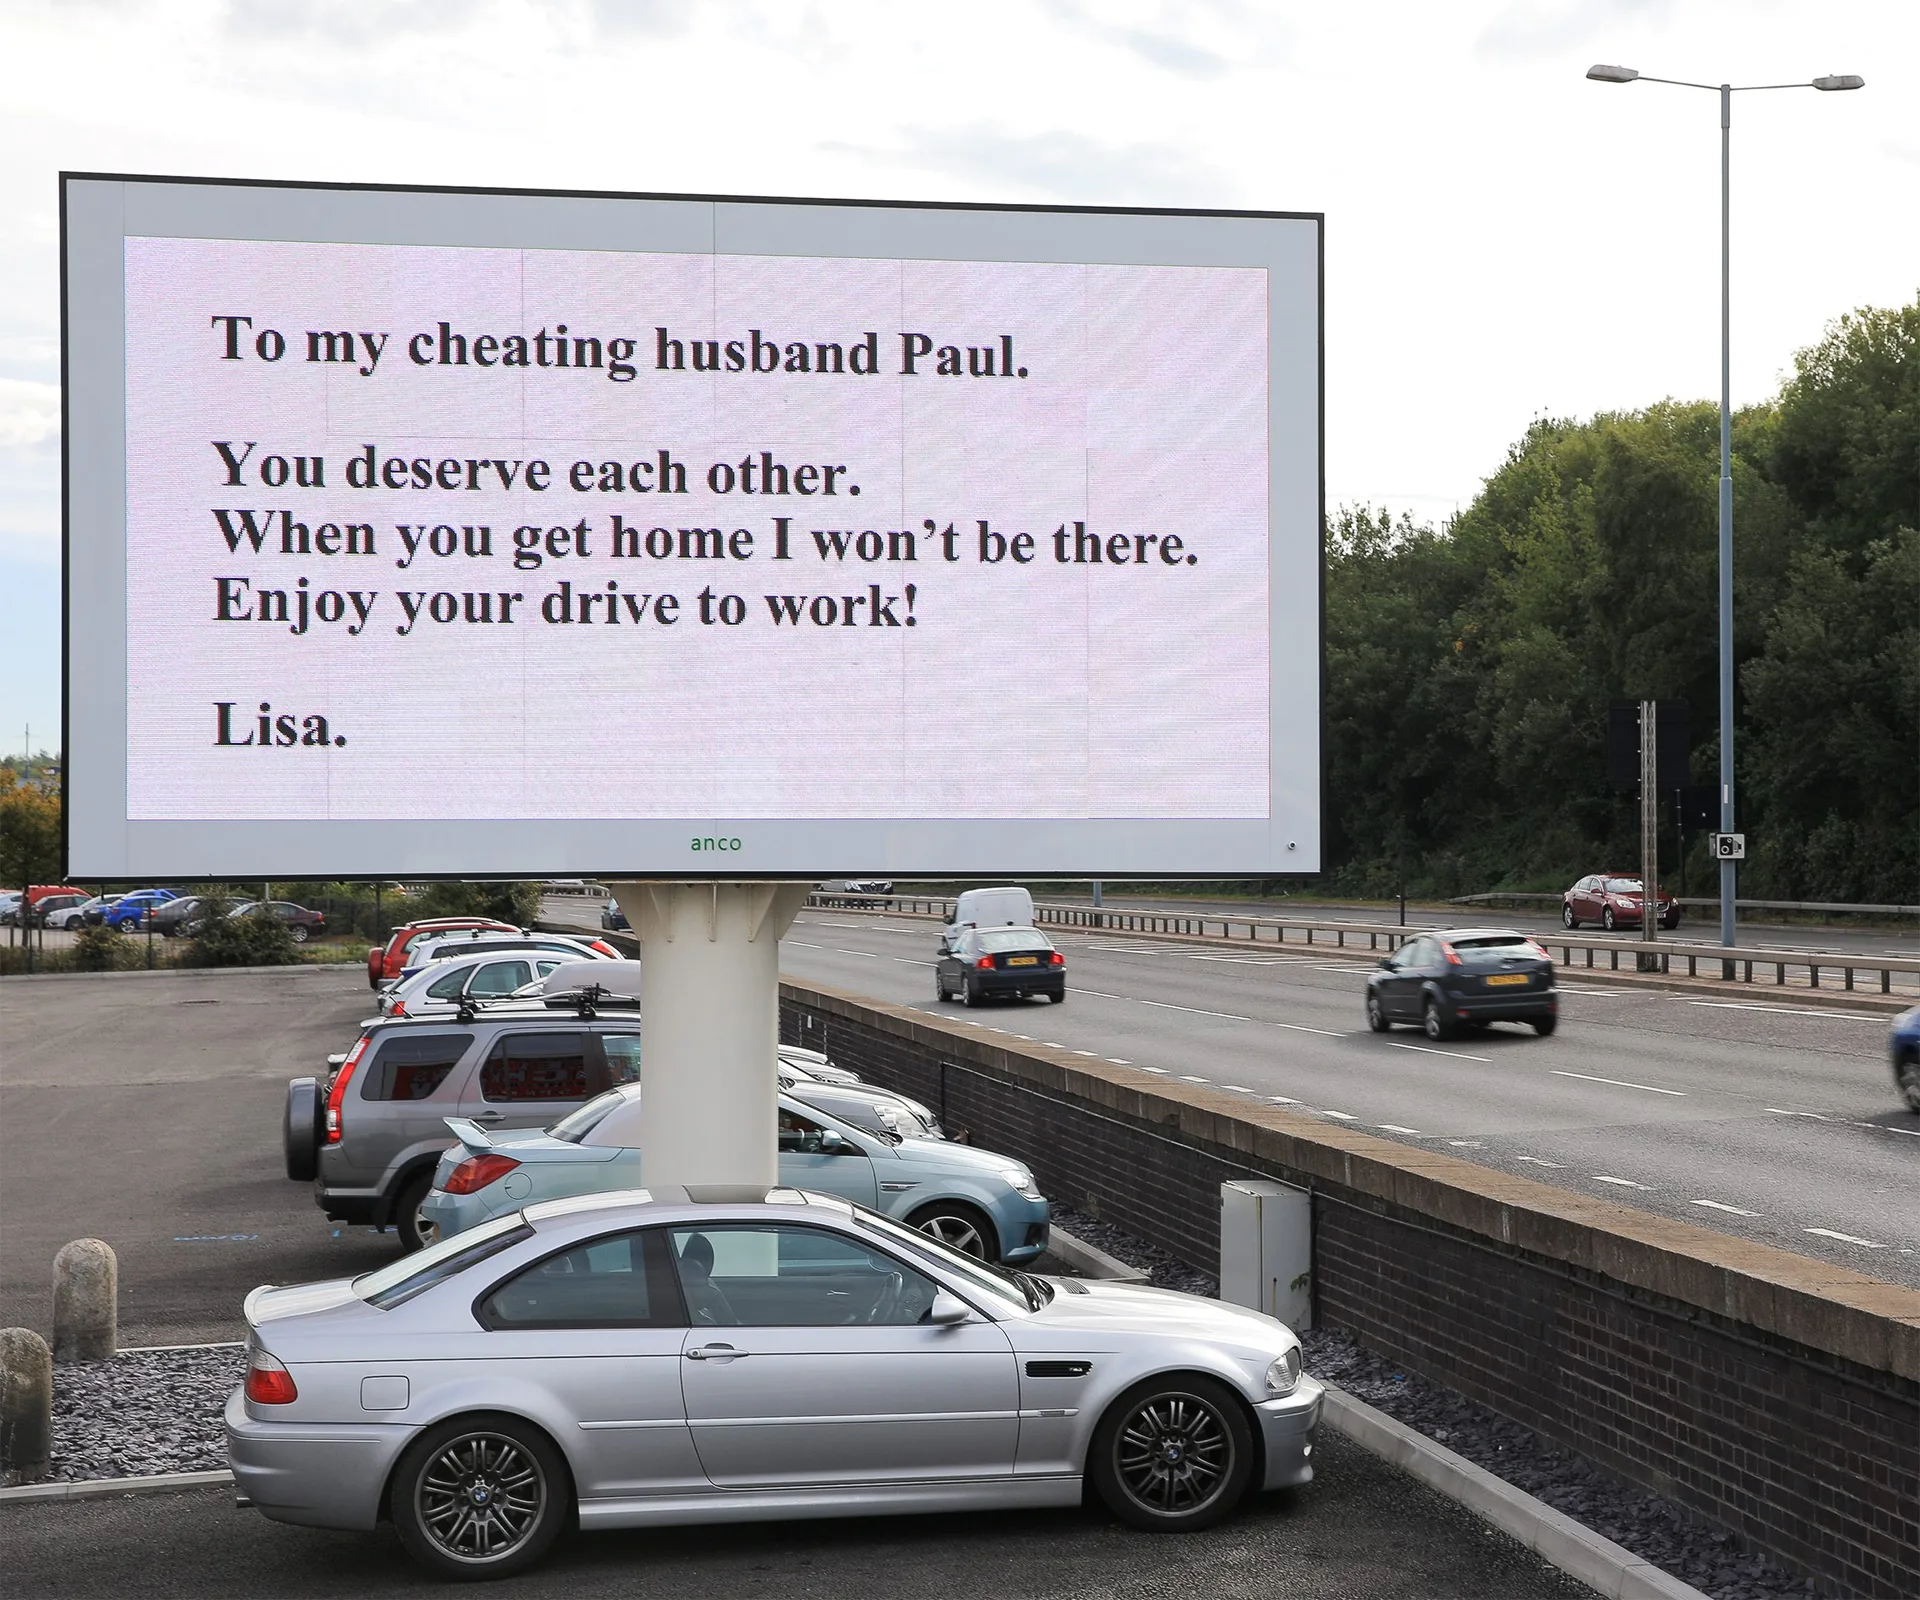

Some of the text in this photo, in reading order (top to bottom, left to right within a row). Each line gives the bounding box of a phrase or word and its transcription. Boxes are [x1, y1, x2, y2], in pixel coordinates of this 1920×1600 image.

[212, 316, 1028, 382] To my cheating husband Paul.
[211, 441, 861, 496] You deserve each other.
[211, 509, 377, 555] When
[395, 525, 493, 569] you
[513, 518, 592, 570] get
[610, 515, 754, 560] home
[771, 517, 793, 560] I
[976, 521, 1035, 564] be
[1053, 522, 1198, 565] there.
[213, 577, 917, 636] Enjoy your drive to work!
[213, 702, 347, 748] Lisa.
[691, 837, 742, 851] anco
